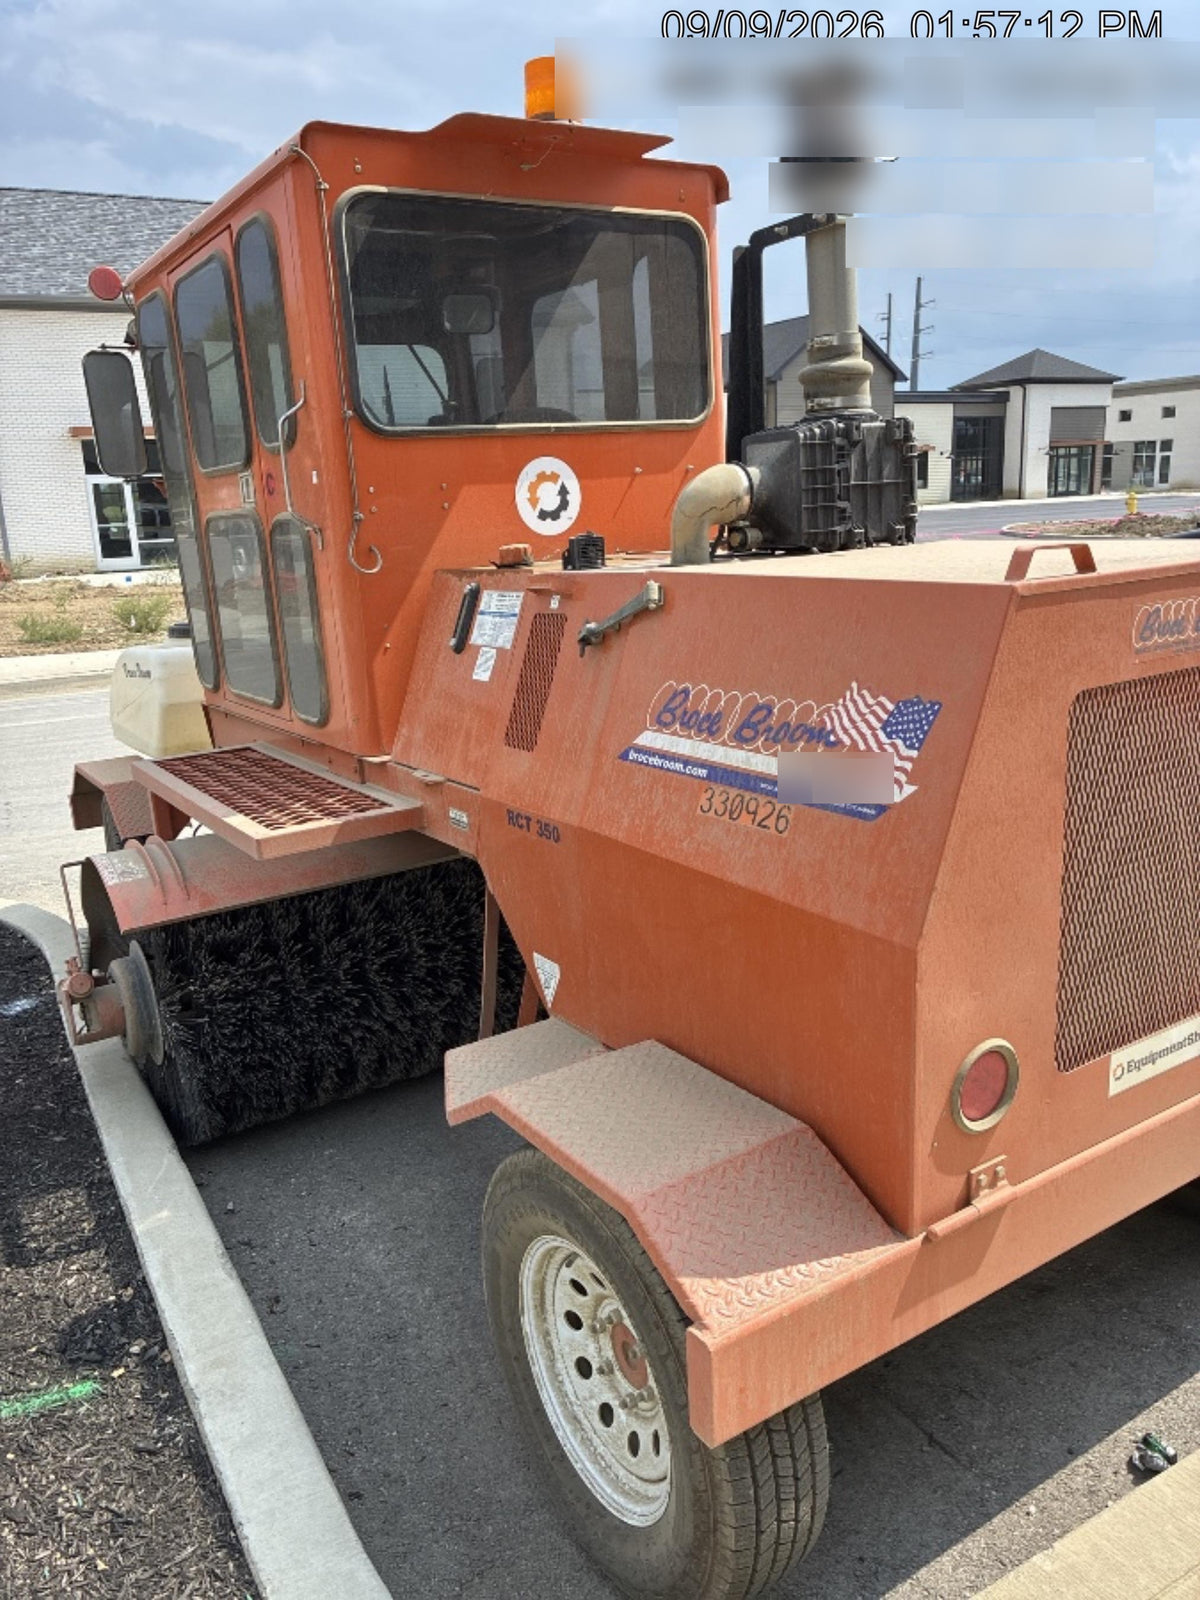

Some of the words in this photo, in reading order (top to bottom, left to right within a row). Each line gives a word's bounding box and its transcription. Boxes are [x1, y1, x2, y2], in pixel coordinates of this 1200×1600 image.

[656, 685, 723, 737] Broce
[628, 749, 708, 778] brocebroom.com
[506, 808, 532, 833] RCT
[536, 819, 561, 844] 350
[700, 786, 791, 834] 330926
